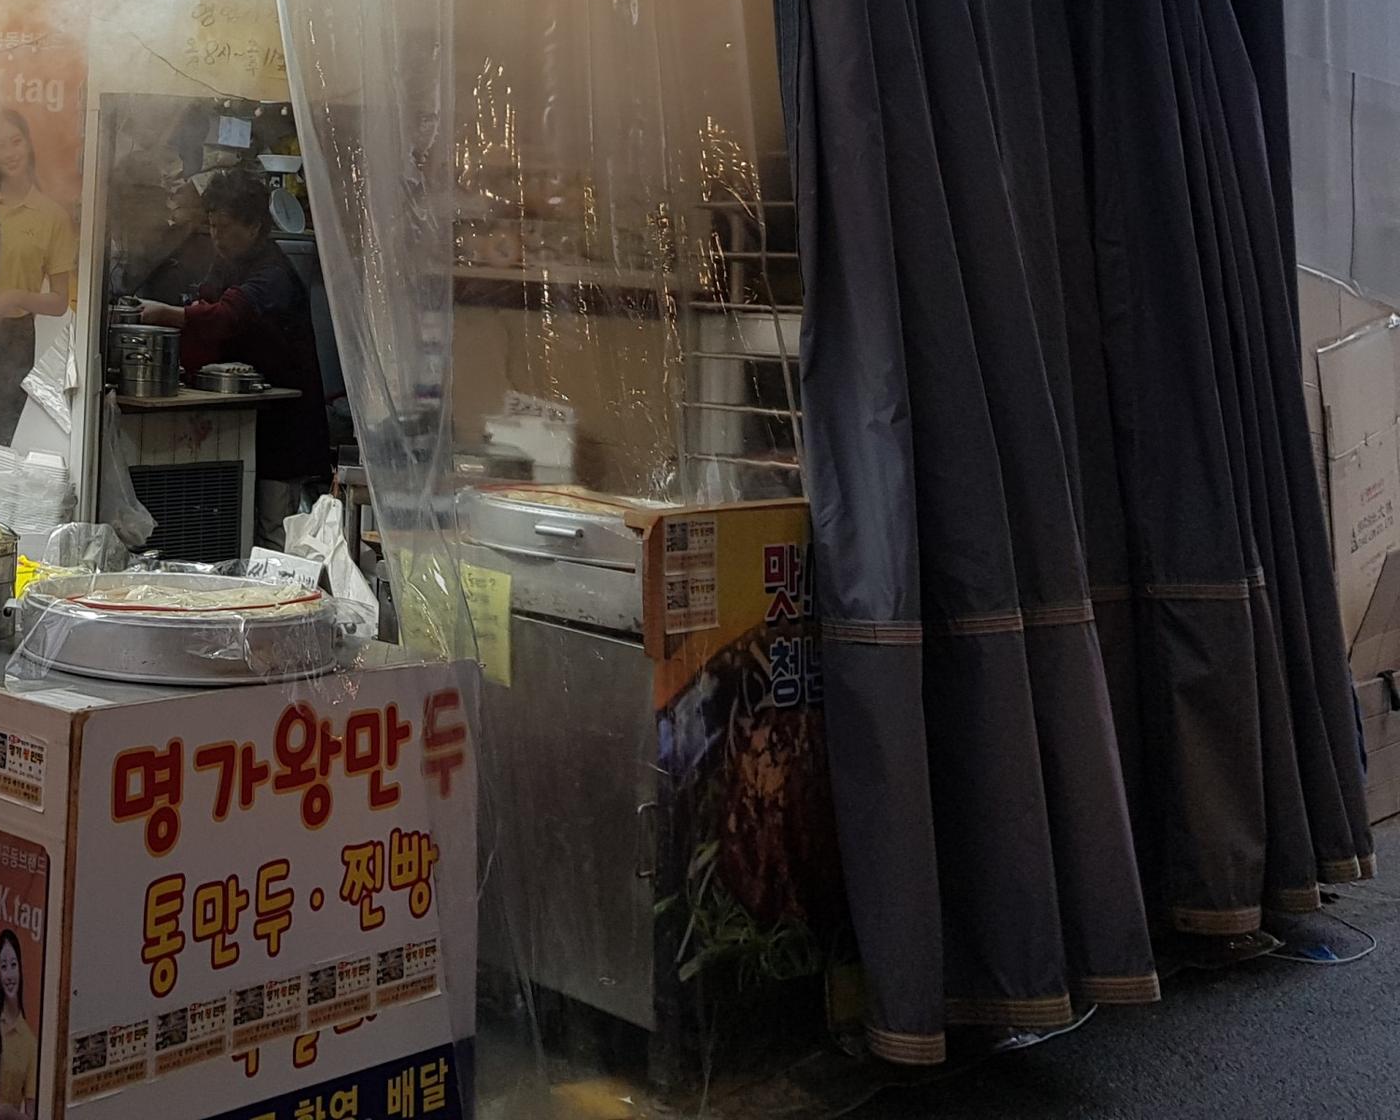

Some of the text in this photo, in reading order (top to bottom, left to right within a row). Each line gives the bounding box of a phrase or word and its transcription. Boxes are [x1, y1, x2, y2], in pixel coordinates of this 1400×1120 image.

[110, 686, 468, 858] 명가왕만두
[141, 827, 439, 999] 통만두 찐빵
[387, 1057, 449, 1118] 배달
